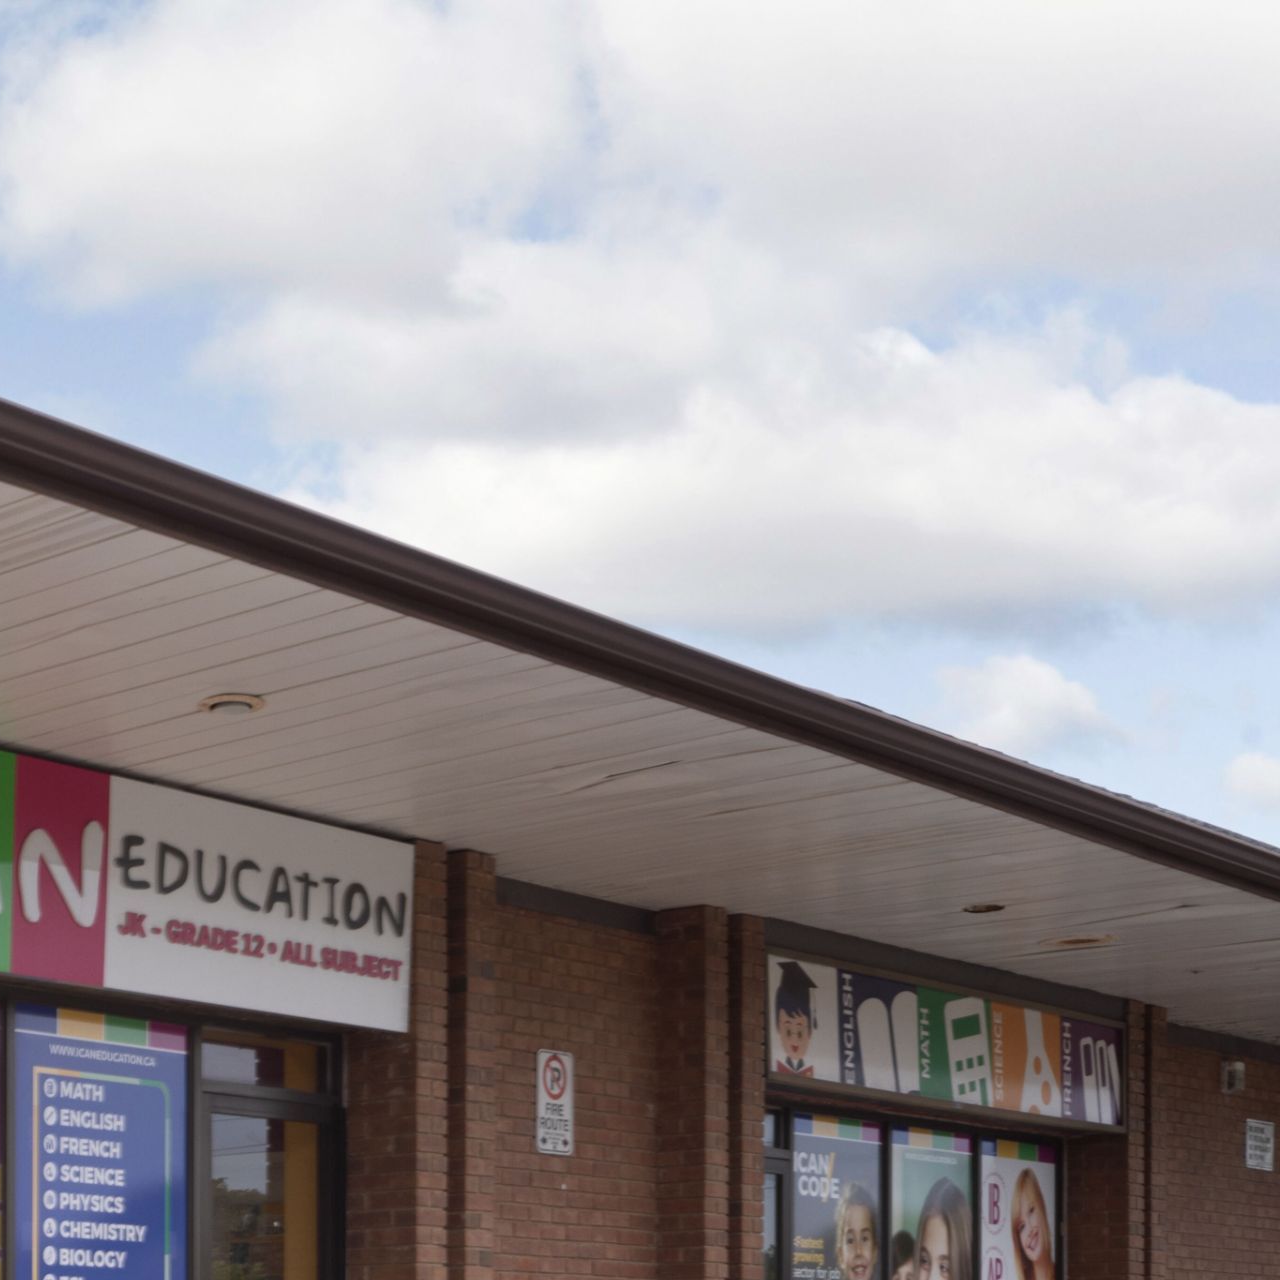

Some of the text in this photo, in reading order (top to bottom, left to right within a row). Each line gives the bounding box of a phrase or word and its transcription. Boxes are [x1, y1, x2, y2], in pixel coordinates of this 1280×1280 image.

[115, 834, 406, 937] EDUCATION
[117, 911, 147, 938] JK
[165, 919, 239, 954] GRADE
[240, 933, 265, 958] 12
[280, 940, 317, 967] ALL
[320, 947, 403, 981] SUBJECT
[841, 973, 856, 1084] ENGLISH
[920, 1008, 931, 1079] MATH
[993, 1011, 1004, 1102] SCIENCE
[1062, 1021, 1073, 1116] FRENCH
[60, 1081, 104, 1102] MATH
[59, 1108, 126, 1132] ENGLISH
[545, 1103, 565, 1117] FIRE
[540, 1117, 569, 1132] ROUTE
[59, 1136, 122, 1159] FRENCH
[60, 1164, 126, 1187] SCIENCE
[798, 1176, 840, 1200] CODE
[59, 1192, 125, 1214] PHYSICS
[59, 1220, 147, 1242] CHEMISTRY
[59, 1248, 127, 1268] BIOLOGY
